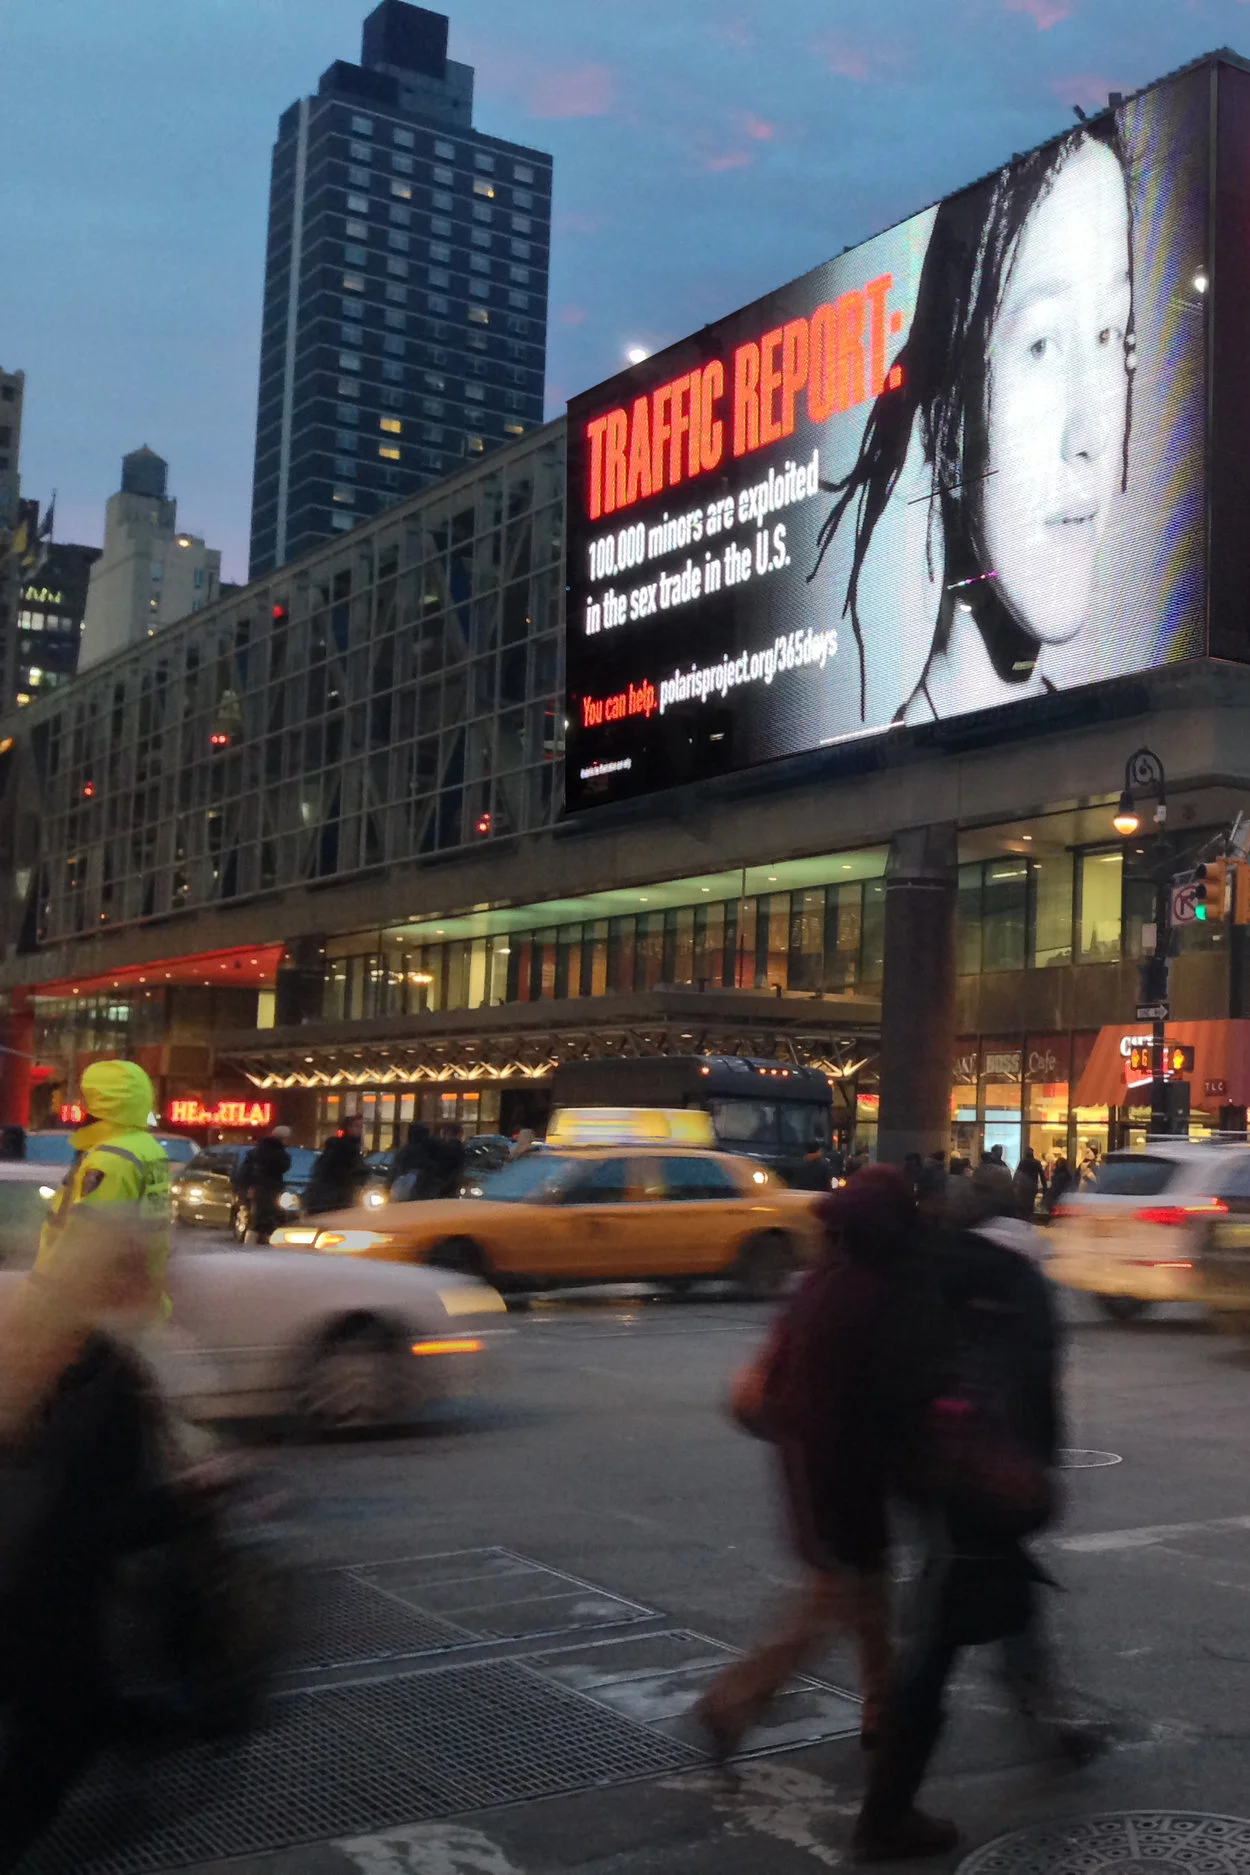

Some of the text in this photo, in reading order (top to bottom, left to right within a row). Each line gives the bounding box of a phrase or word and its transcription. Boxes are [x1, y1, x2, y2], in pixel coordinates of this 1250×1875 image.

[587, 272, 903, 521] TRAFFIC REPORT:
[588, 449, 819, 582] 100,000 minors are exploited
[585, 523, 791, 636] in the sex trade in the U.S.
[583, 627, 839, 728] You can help. polarisproject.org/365days
[1028, 1049, 1056, 1074] Cafe
[1205, 1081, 1225, 1092] TLC
